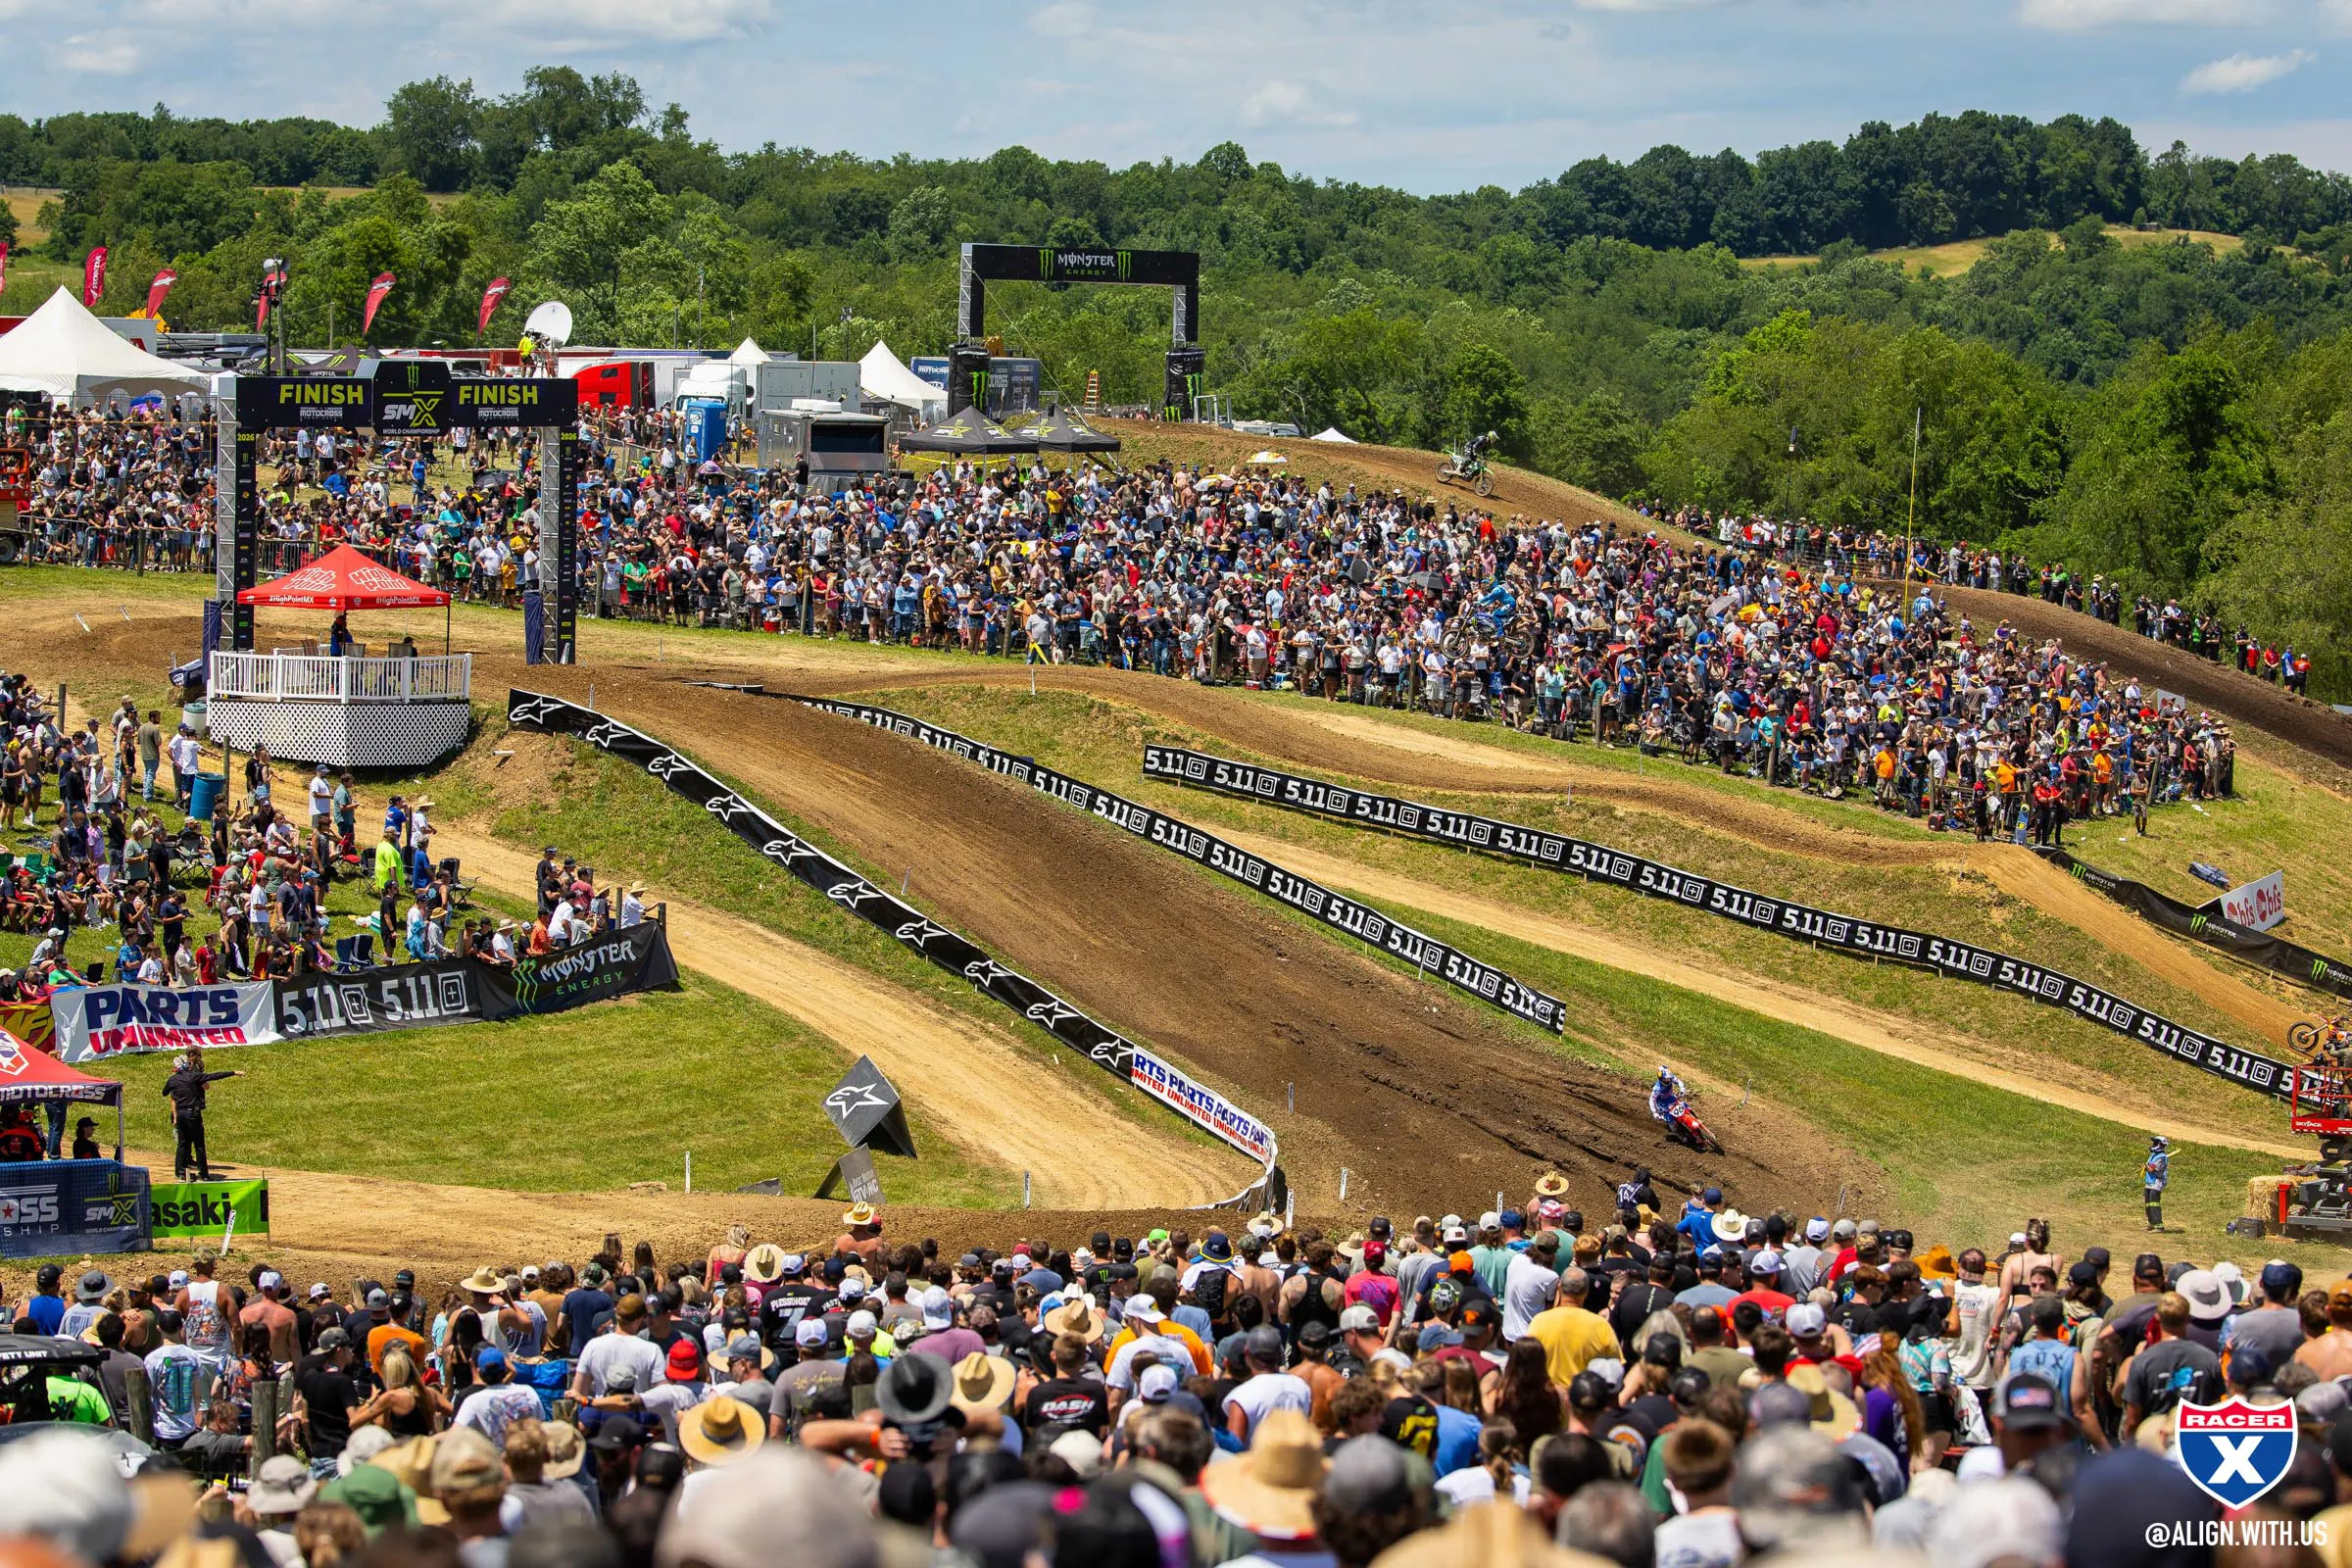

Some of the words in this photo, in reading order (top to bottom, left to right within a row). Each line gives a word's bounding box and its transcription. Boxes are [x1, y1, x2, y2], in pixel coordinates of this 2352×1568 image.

[1058, 252, 1115, 268] MONSTER
[90, 254, 103, 289] HONDA
[279, 384, 365, 405] FINISH
[459, 385, 538, 405] FINISH
[382, 398, 440, 427] SMX
[237, 432, 255, 441] 2026
[561, 431, 577, 440] 2026
[282, 580, 336, 592] Point
[295, 567, 337, 585] High
[349, 567, 391, 585] High
[363, 577, 411, 591] Point
[269, 594, 315, 605] #HighPointMX
[375, 595, 421, 606] #HighPointMX
[1093, 795, 1128, 828] 5.11
[1152, 819, 1188, 853] 5.11
[1209, 843, 1245, 878] 5.11
[1268, 870, 1304, 905] 5.11
[1328, 899, 1364, 934] 5.11
[1388, 927, 1423, 963] 5.11
[1446, 955, 1480, 990] 5.11
[1146, 749, 1184, 776] 5.11
[1214, 763, 1254, 792] 5.11
[1285, 780, 1325, 808] 5.11
[1355, 797, 1396, 825] 5.11
[1426, 812, 1467, 841] 5.11
[1498, 829, 1539, 857] 5.11
[1570, 845, 1610, 874] 5.11
[1639, 866, 1681, 897] 5.11
[1710, 888, 1751, 918] 5.11
[1783, 908, 1823, 938] 5.11
[1854, 926, 1896, 954] 5.11
[1928, 941, 1968, 971] 5.11
[1999, 960, 2039, 993] 5.11
[2069, 986, 2109, 1021] 5.11
[2137, 1016, 2179, 1052] 5.11
[2207, 1047, 2250, 1080] 5.11
[2205, 922, 2237, 939] MONSTER
[539, 938, 637, 984] MONSTER
[557, 970, 624, 995] ENERGY
[2327, 967, 2352, 982] MONSTE
[84, 987, 240, 1029] PARTS
[381, 975, 439, 1022] 5.11
[281, 986, 346, 1032] 5.11
[1167, 1088, 1211, 1124] UNLIMITED
[1168, 1072, 1215, 1113] PARTS
[1214, 1102, 1250, 1137] PARTS
[1673, 1104, 1686, 1117] 96
[84, 1199, 137, 1225] SMX
